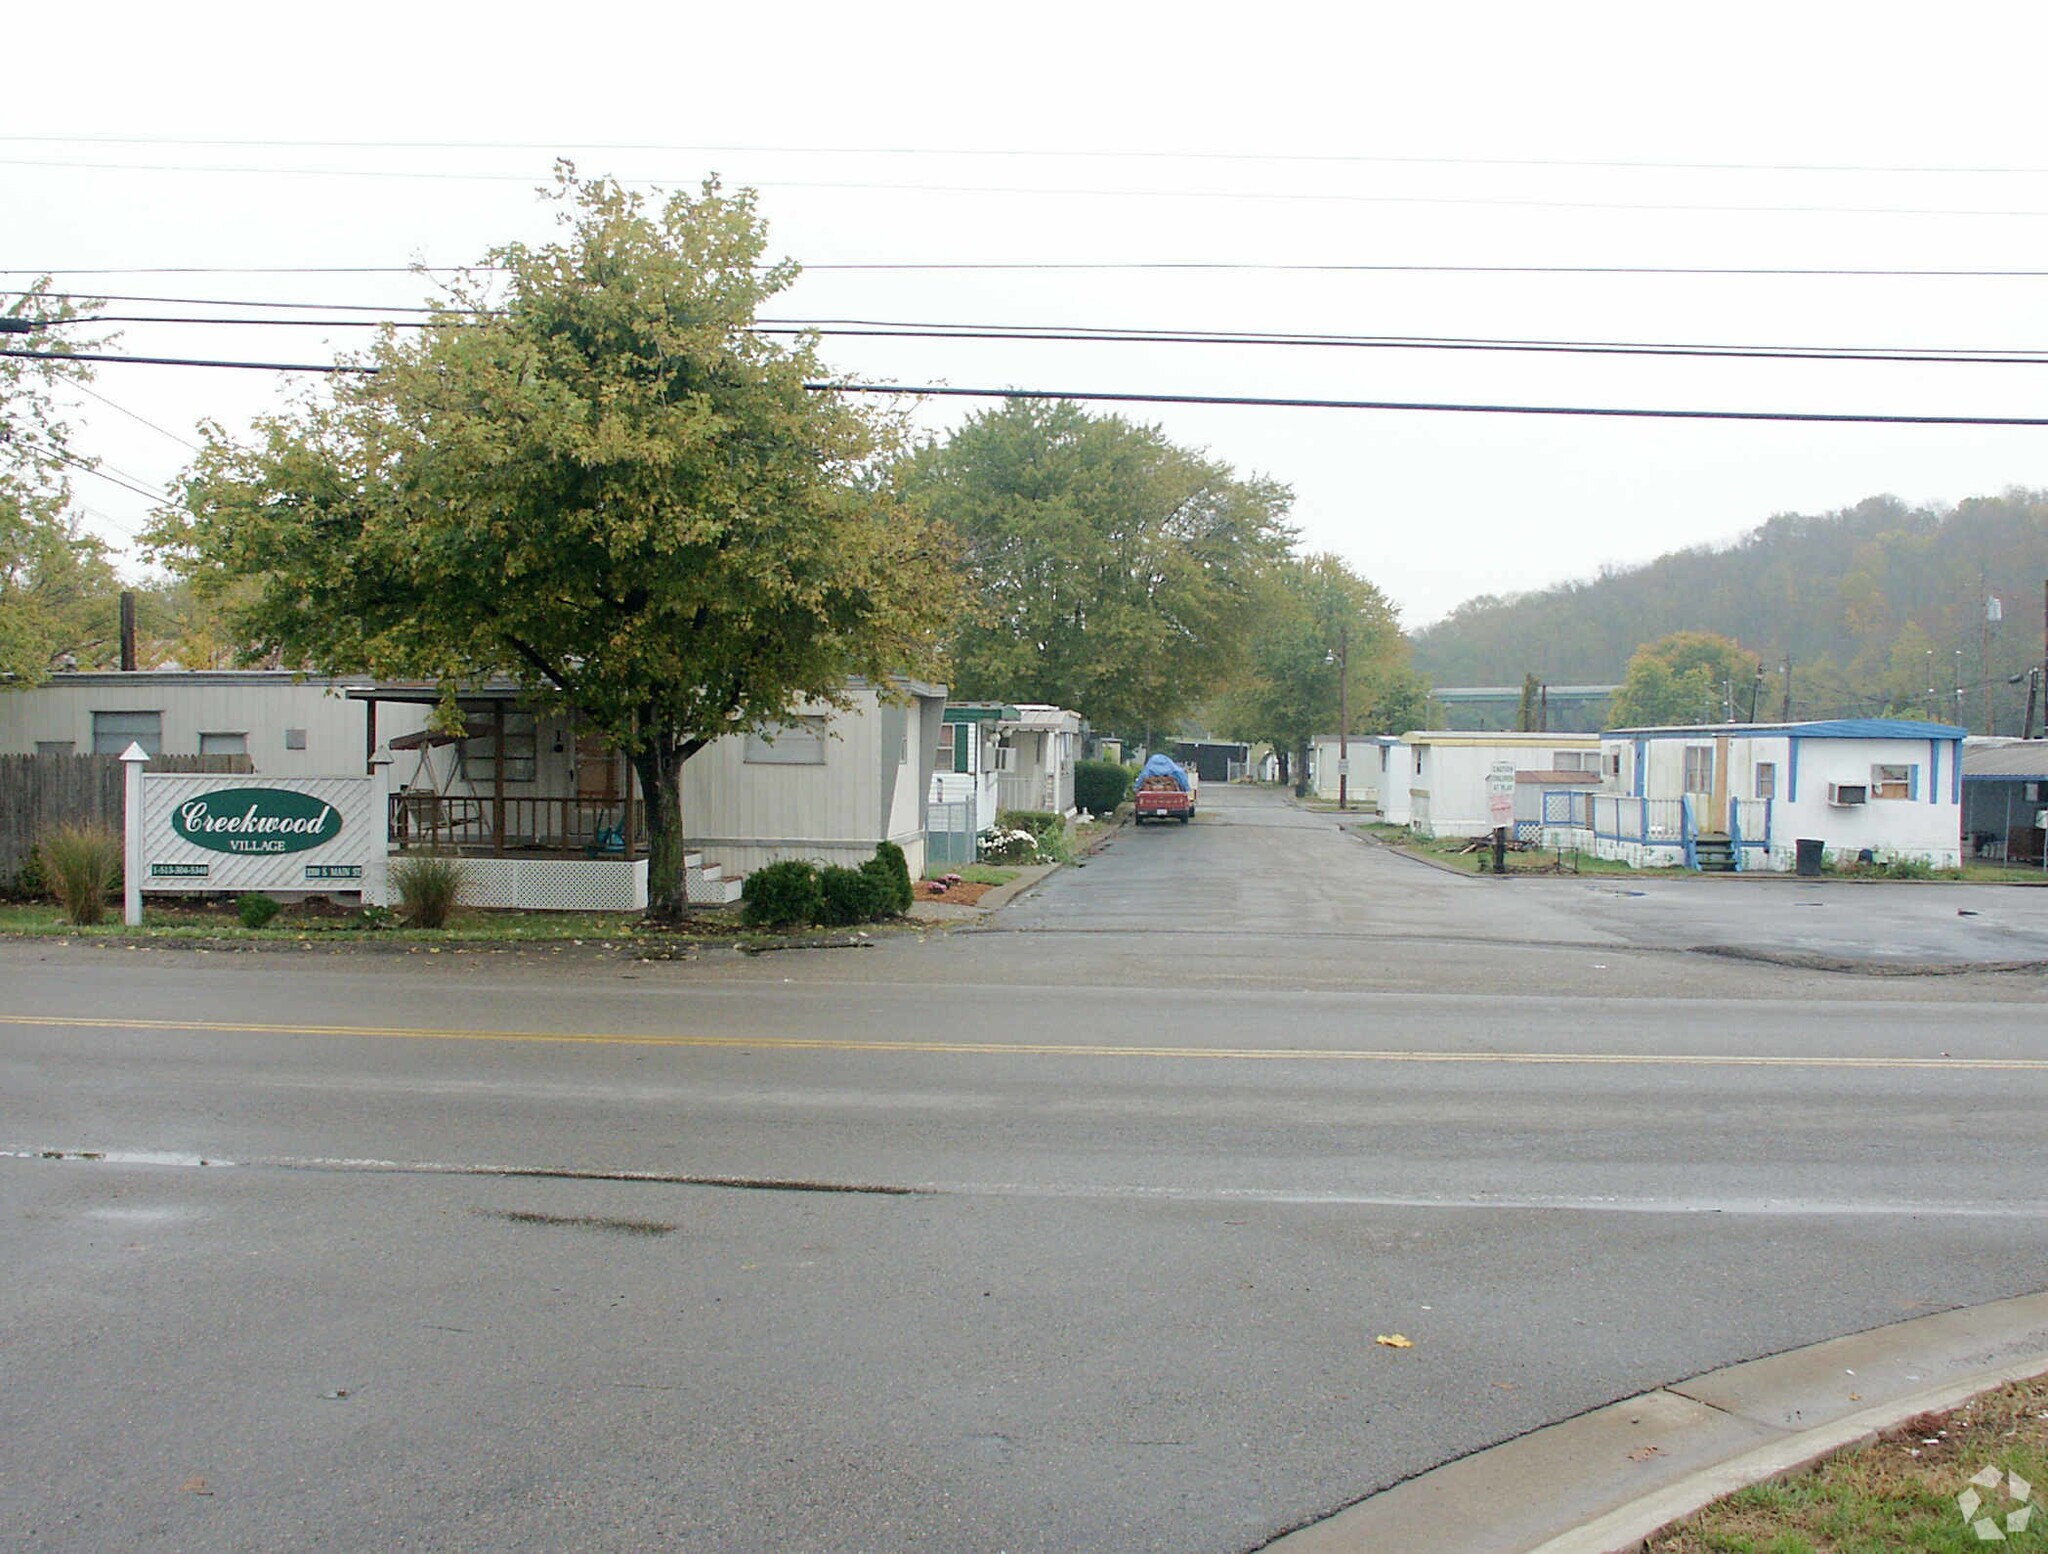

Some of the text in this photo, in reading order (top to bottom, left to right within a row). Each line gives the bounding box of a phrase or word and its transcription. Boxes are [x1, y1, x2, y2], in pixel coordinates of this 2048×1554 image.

[181, 801, 331, 834] Creekwood
[229, 840, 286, 851] VILLAGE
[330, 867, 351, 877] MAIN
